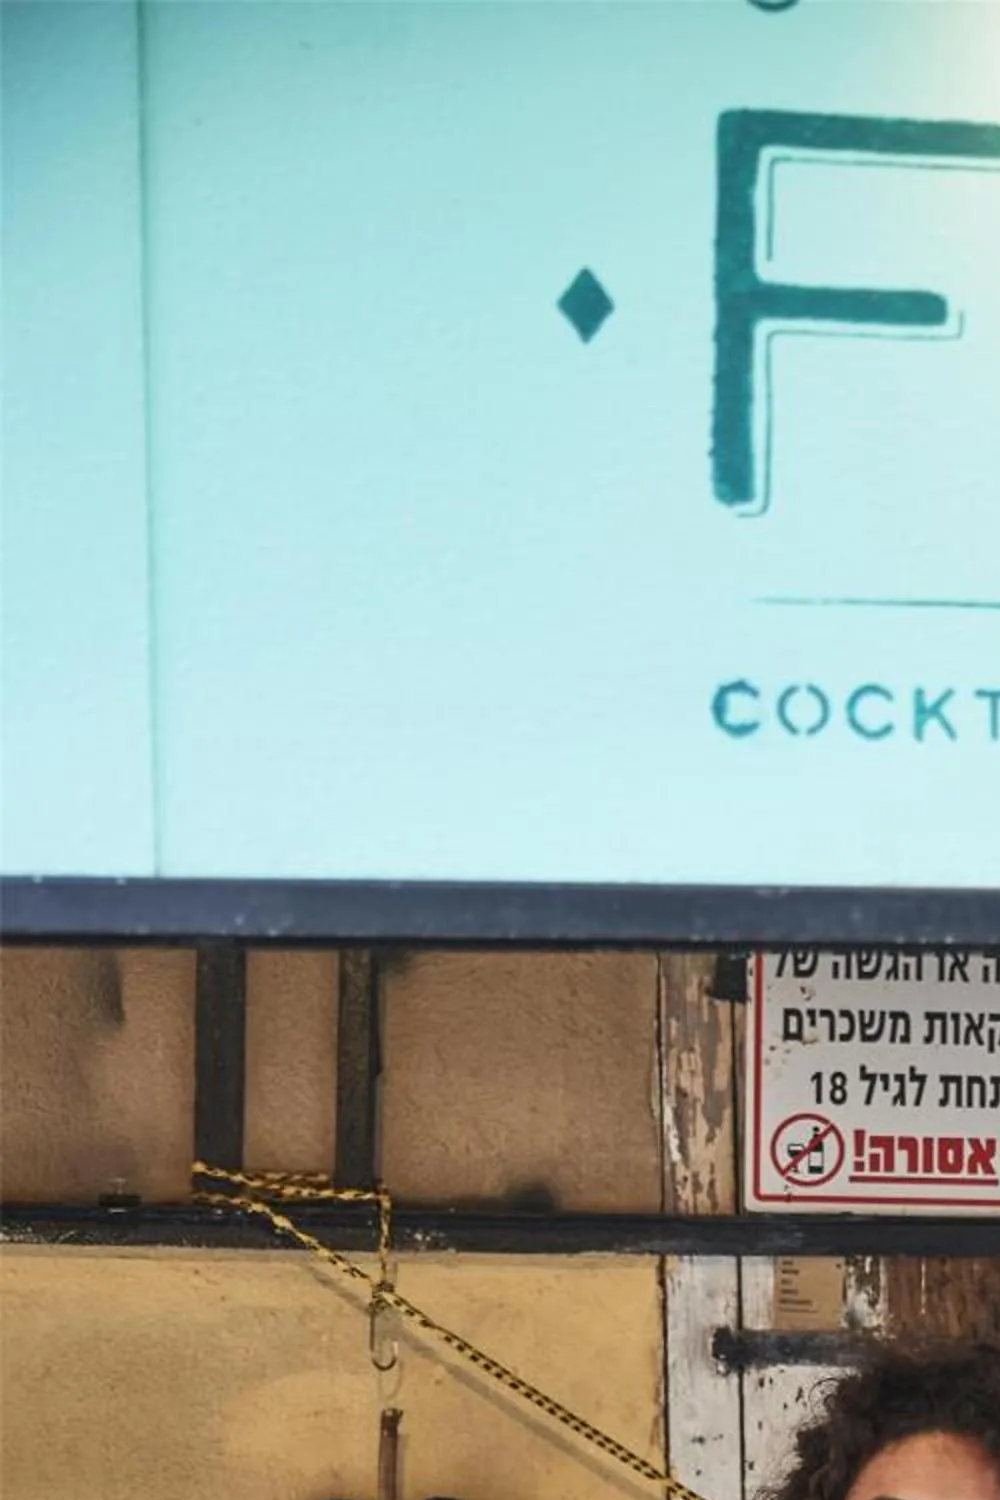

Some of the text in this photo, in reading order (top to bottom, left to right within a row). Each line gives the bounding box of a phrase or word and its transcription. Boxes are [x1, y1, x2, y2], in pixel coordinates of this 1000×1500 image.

[831, 952, 923, 982] הגשה
[935, 953, 970, 984] או
[782, 1006, 911, 1044] משכרים
[809, 1071, 848, 1105] 18
[859, 1064, 928, 1107] לגיל
[852, 1128, 997, 1176] אסורה!
